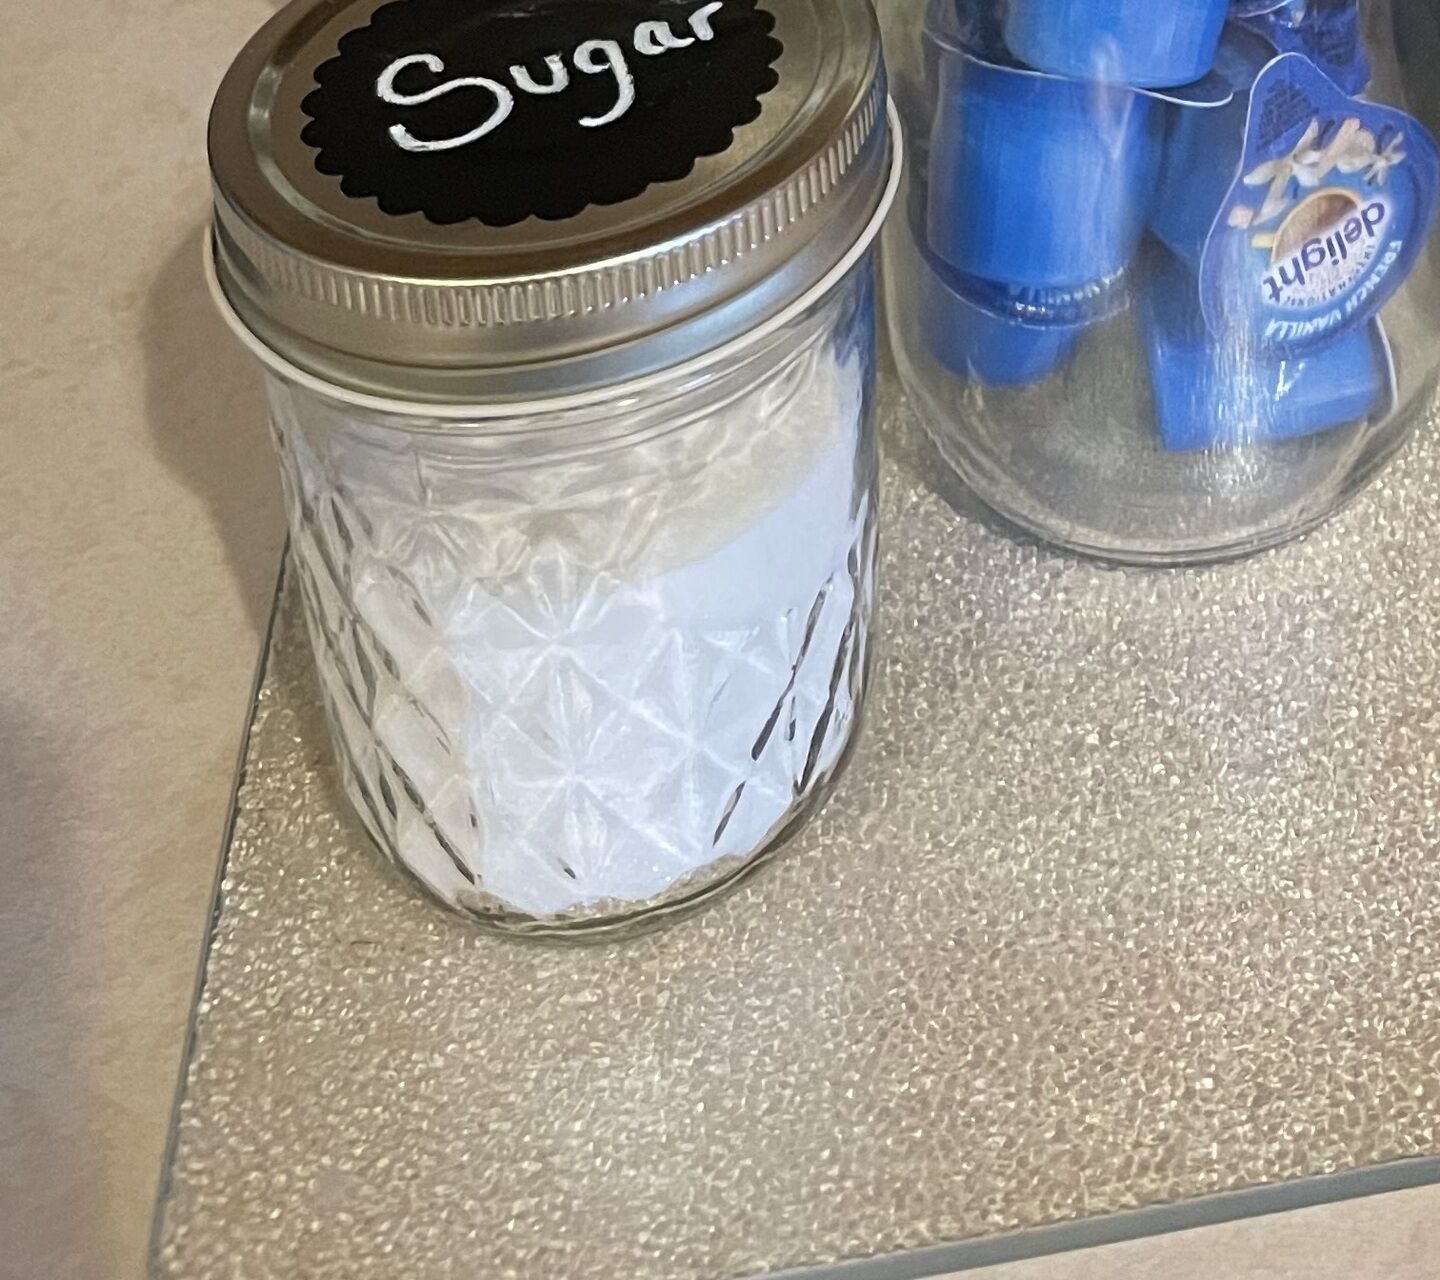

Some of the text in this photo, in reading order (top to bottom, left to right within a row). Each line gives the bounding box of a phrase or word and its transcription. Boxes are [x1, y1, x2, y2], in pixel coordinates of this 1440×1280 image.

[376, 1, 724, 152] Sugar
[1262, 201, 1386, 304] delight
[1345, 239, 1403, 313] FRENCH
